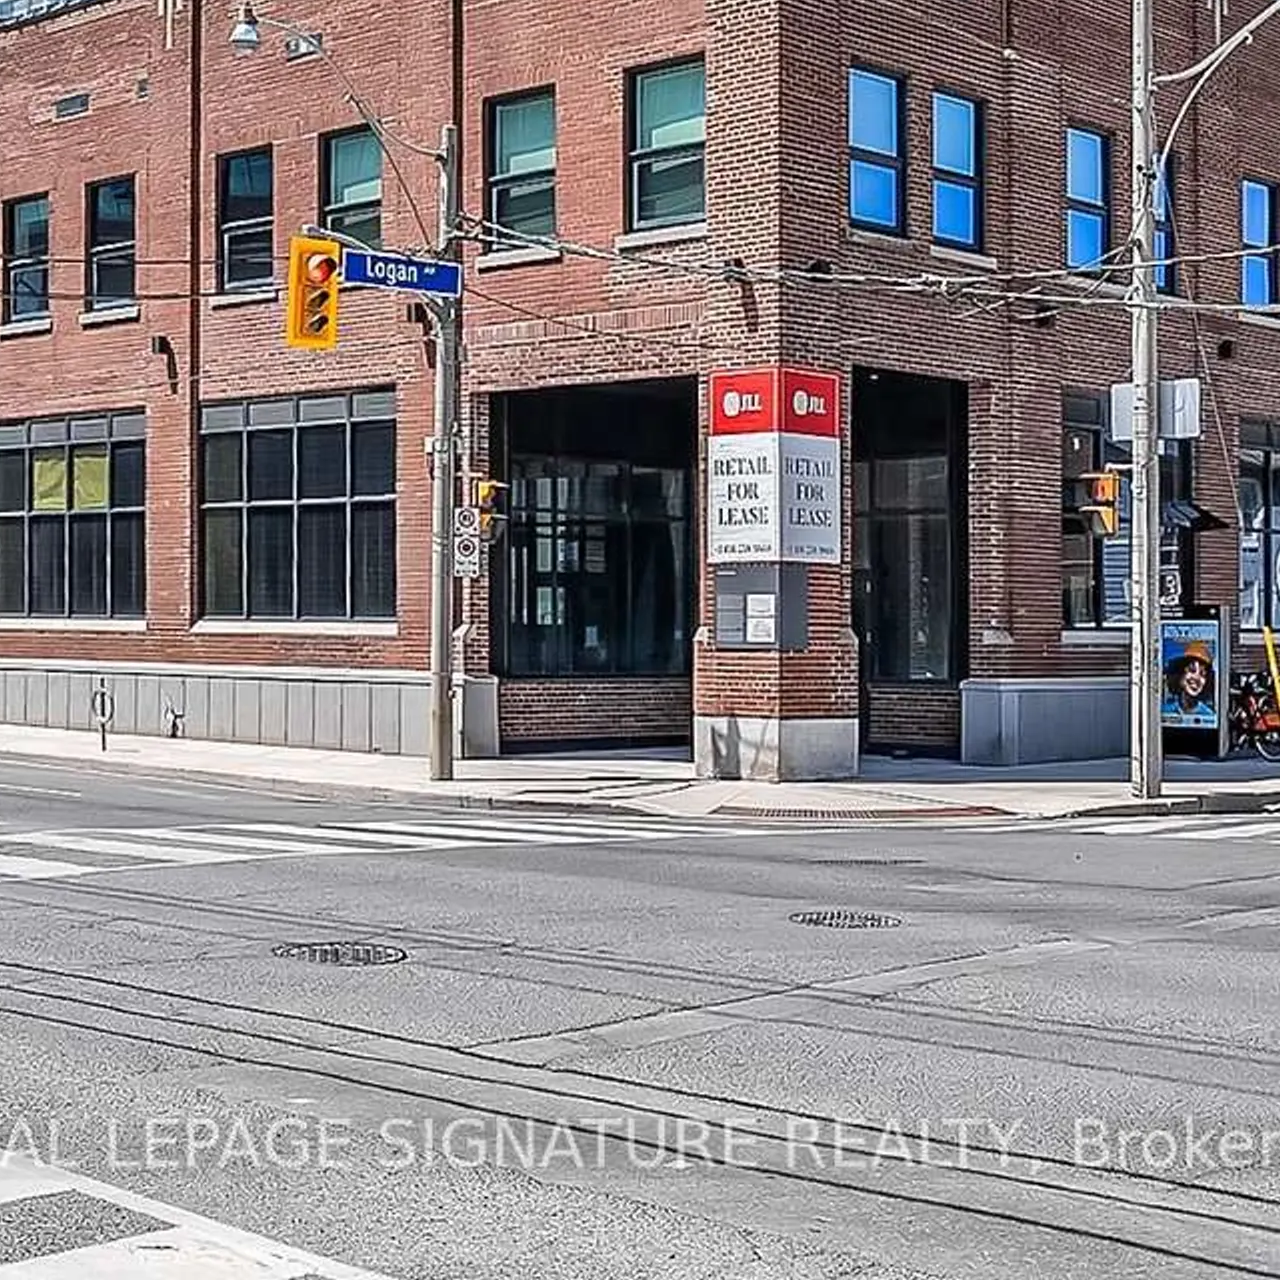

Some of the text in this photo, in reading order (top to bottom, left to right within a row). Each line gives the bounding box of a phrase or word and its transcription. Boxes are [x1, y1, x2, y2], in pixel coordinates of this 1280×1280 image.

[366, 256, 418, 285] Logan
[714, 456, 772, 476] RETAIL
[785, 456, 834, 478] RETAIL
[727, 482, 760, 501] FOR
[796, 482, 825, 501] FOR
[718, 506, 769, 526] LEASE
[789, 508, 832, 527] LEASE
